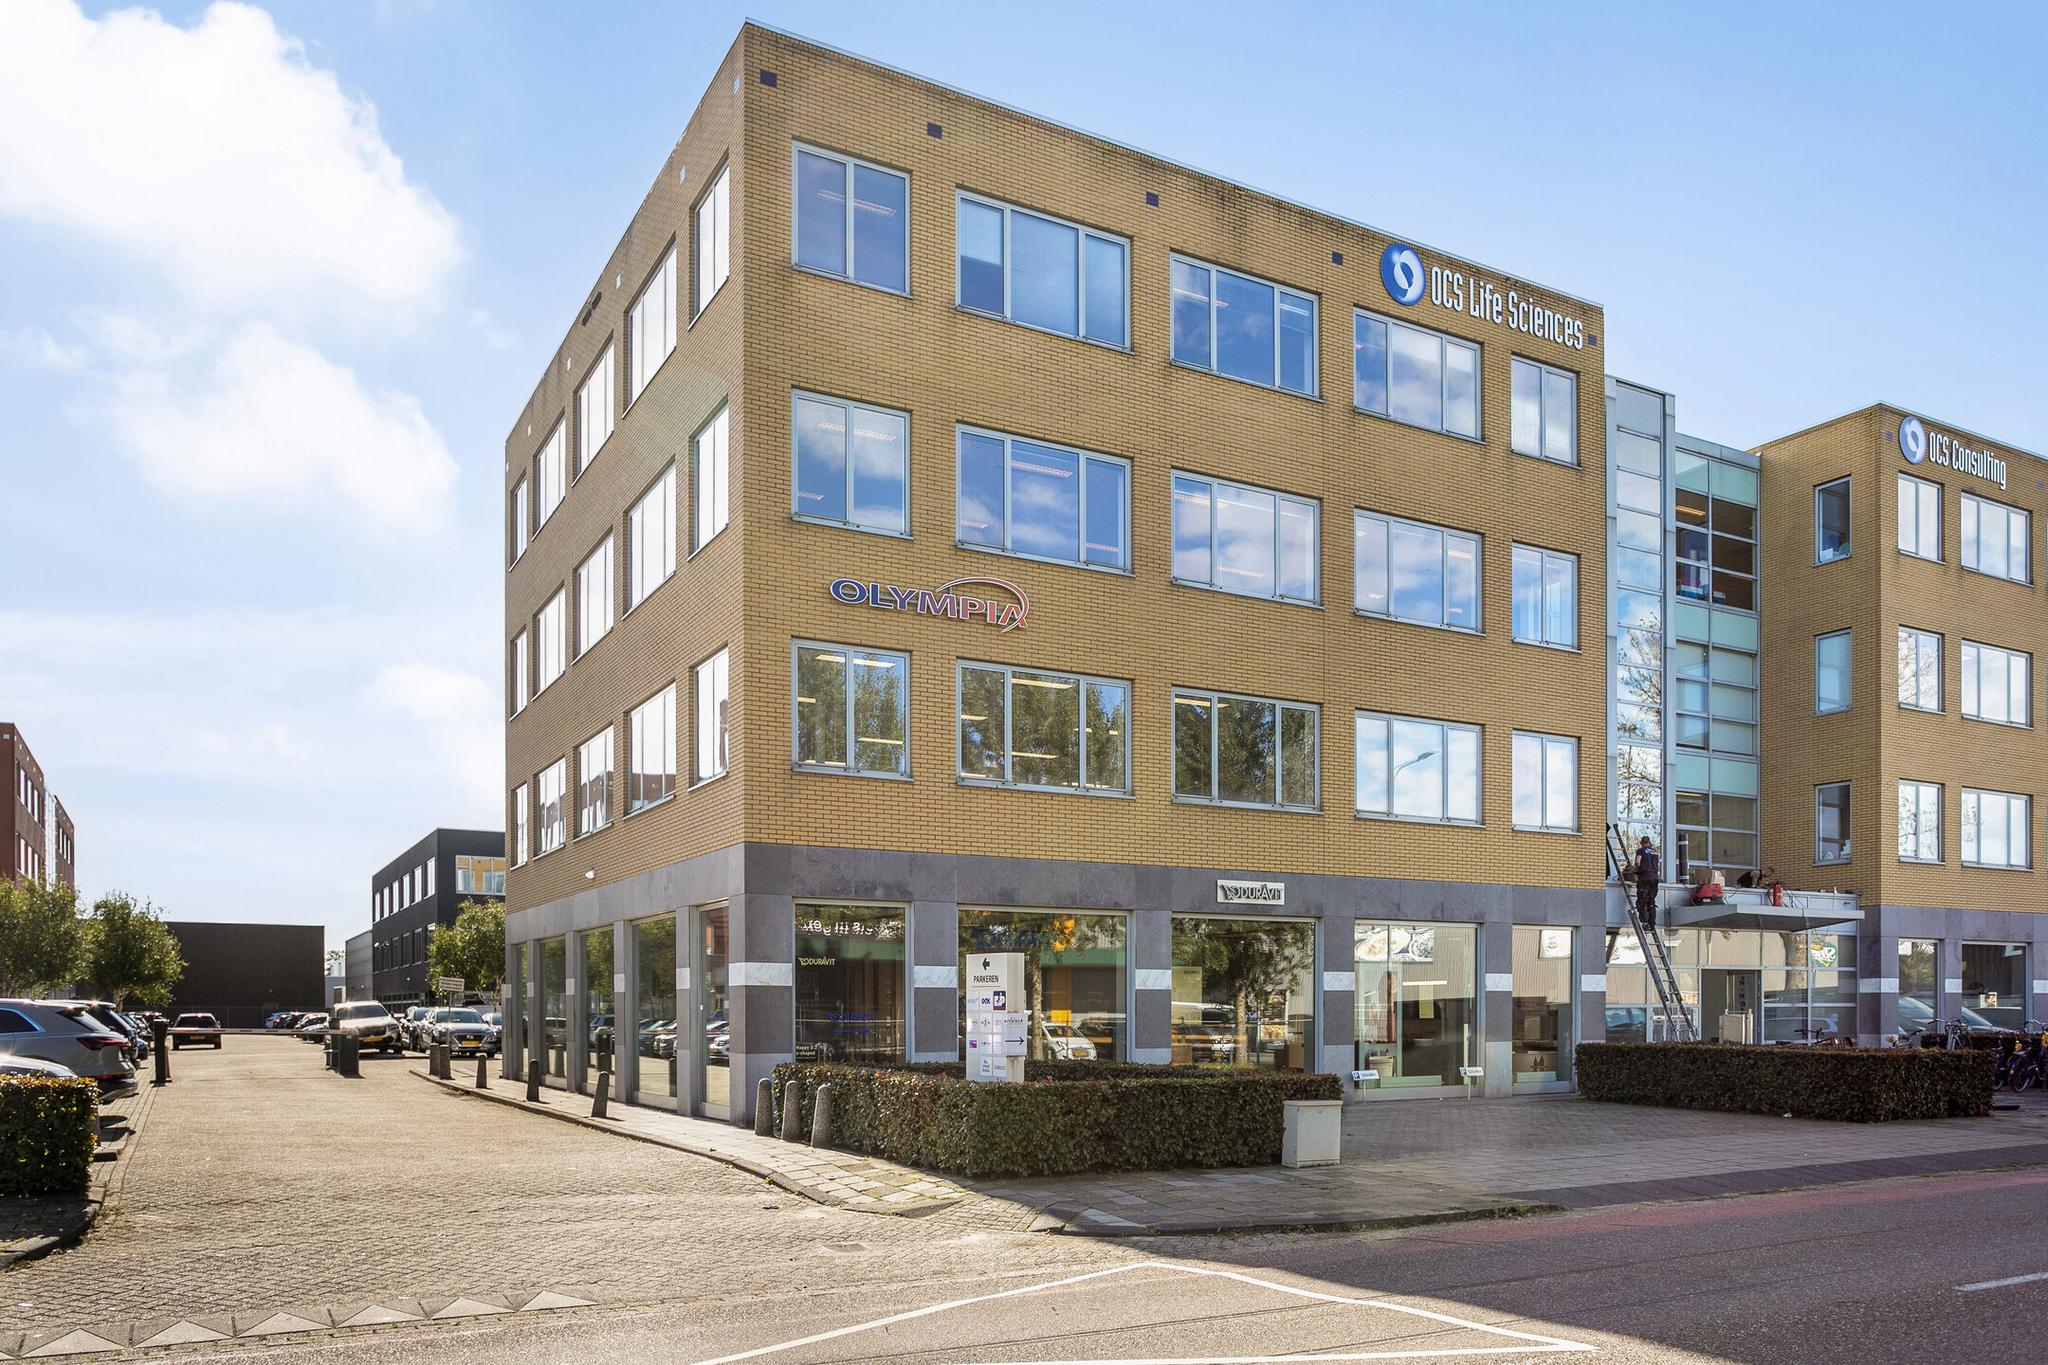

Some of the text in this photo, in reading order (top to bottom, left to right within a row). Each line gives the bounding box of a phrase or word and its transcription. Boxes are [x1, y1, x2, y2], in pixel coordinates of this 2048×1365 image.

[1431, 266, 1584, 350] OCS Life Sciences
[1929, 432, 2007, 491] OCS Consulting
[829, 577, 1029, 629] OLYMPIA
[809, 956, 836, 966] DURAVIT
[973, 974, 999, 983] PARKEREN
